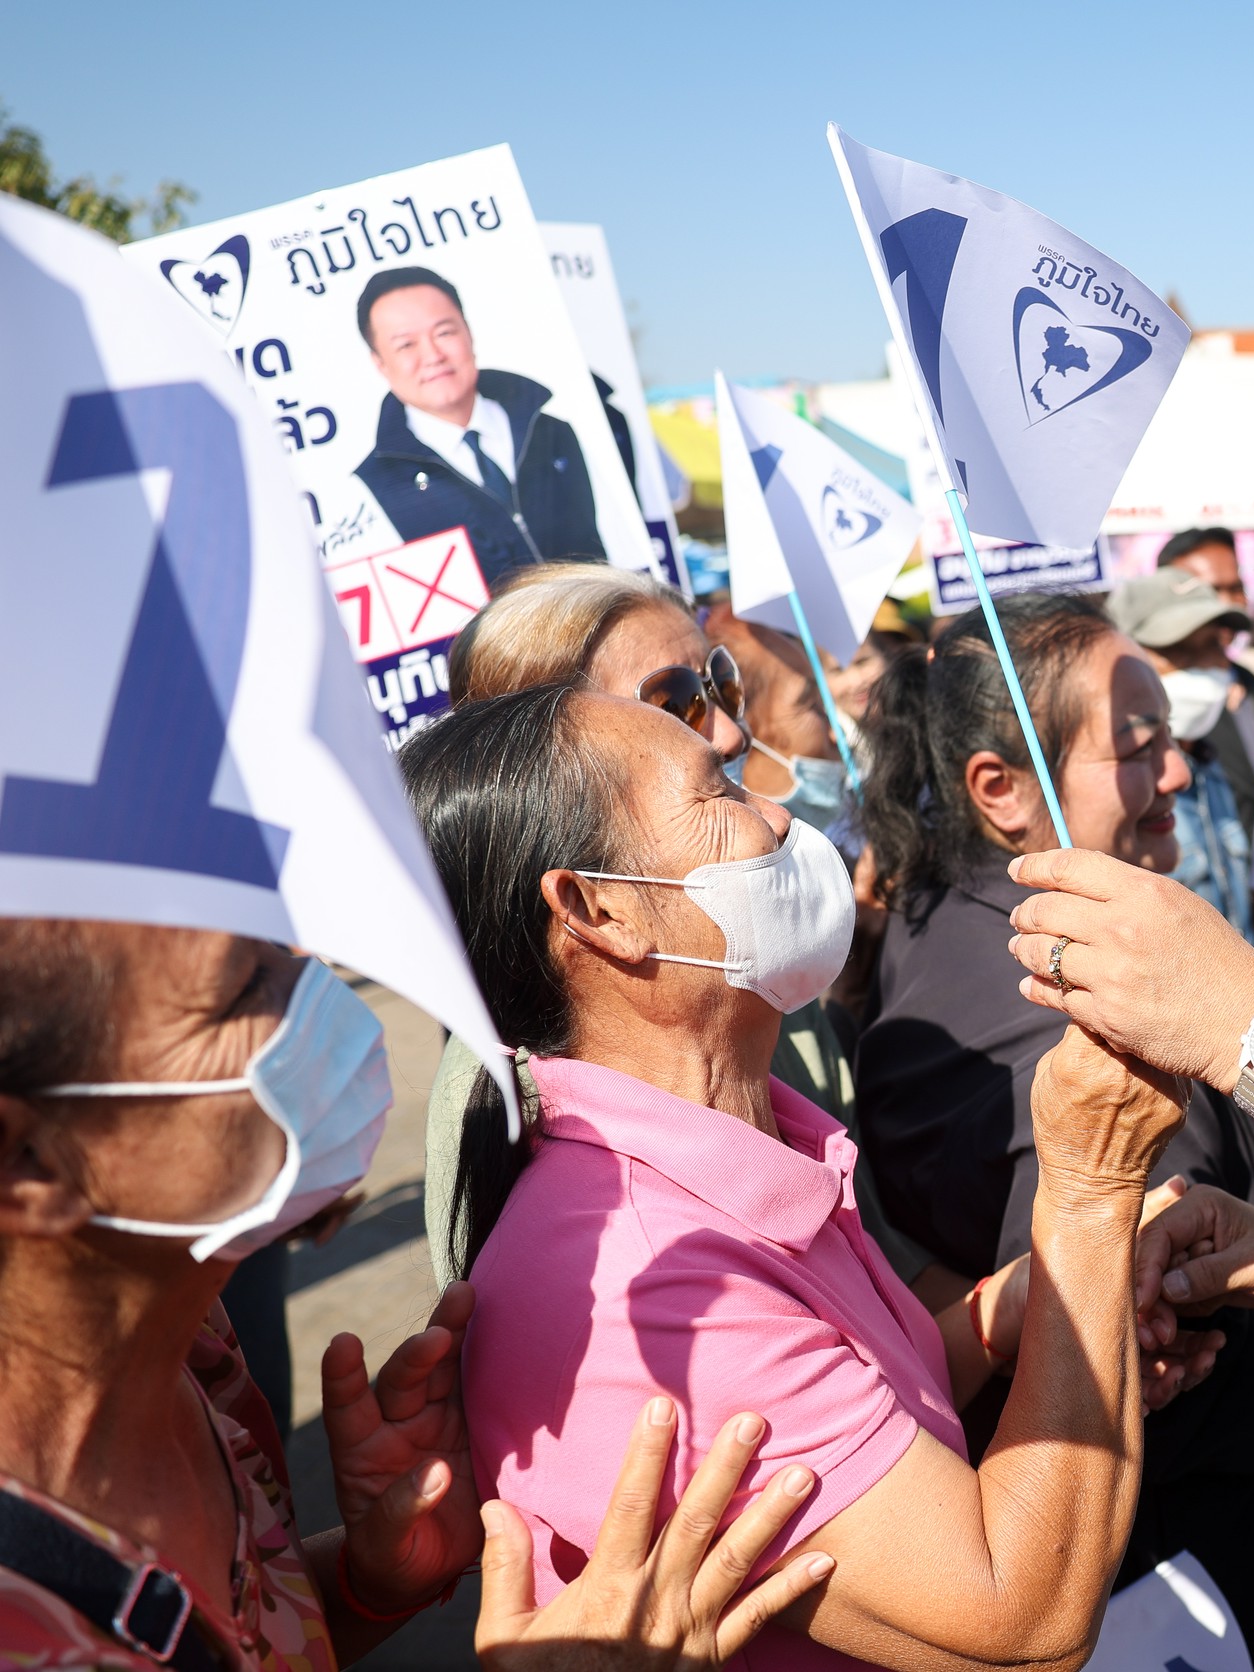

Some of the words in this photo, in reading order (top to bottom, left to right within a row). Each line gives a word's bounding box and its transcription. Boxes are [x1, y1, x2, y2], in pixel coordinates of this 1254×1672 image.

[286, 196, 502, 296] ภูมิใจไทย
[1037, 244, 1066, 264] พรรค
[1031, 256, 1160, 338] ภูมิใจไทย
[335, 585, 371, 645] 7
[366, 648, 450, 724] นุทิ
